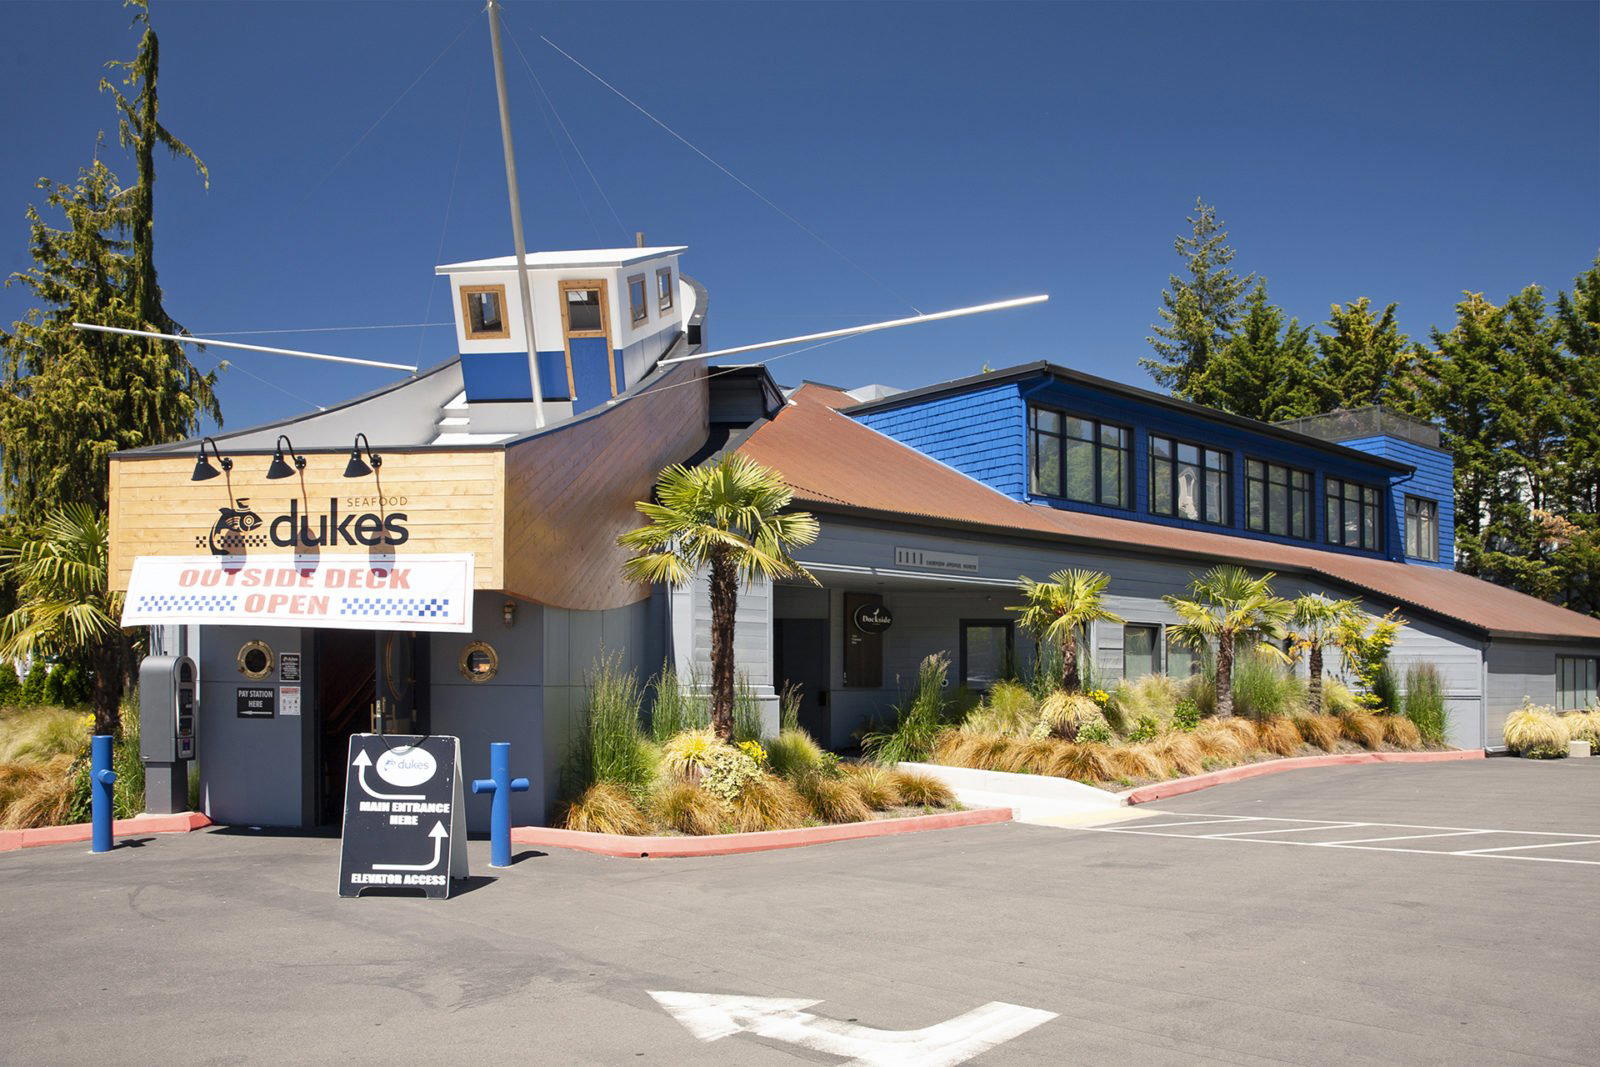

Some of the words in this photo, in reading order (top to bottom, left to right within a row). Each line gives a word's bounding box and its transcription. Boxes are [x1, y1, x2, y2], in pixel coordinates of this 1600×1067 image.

[346, 496, 408, 507] SEAFOOD
[269, 497, 409, 547] dukes
[178, 567, 317, 588] OUTSIDE
[324, 568, 411, 589] DECK
[243, 593, 331, 615] OPEN
[238, 690, 249, 698] PAY
[250, 690, 273, 698] STATION
[248, 700, 263, 708] HERE
[397, 759, 430, 771] dukes
[359, 801, 390, 812] MAIN
[391, 802, 451, 814] ENTRANCE
[389, 815, 419, 826] HERE
[350, 873, 403, 884] ELEVATOR
[403, 874, 447, 886] ACCESS
